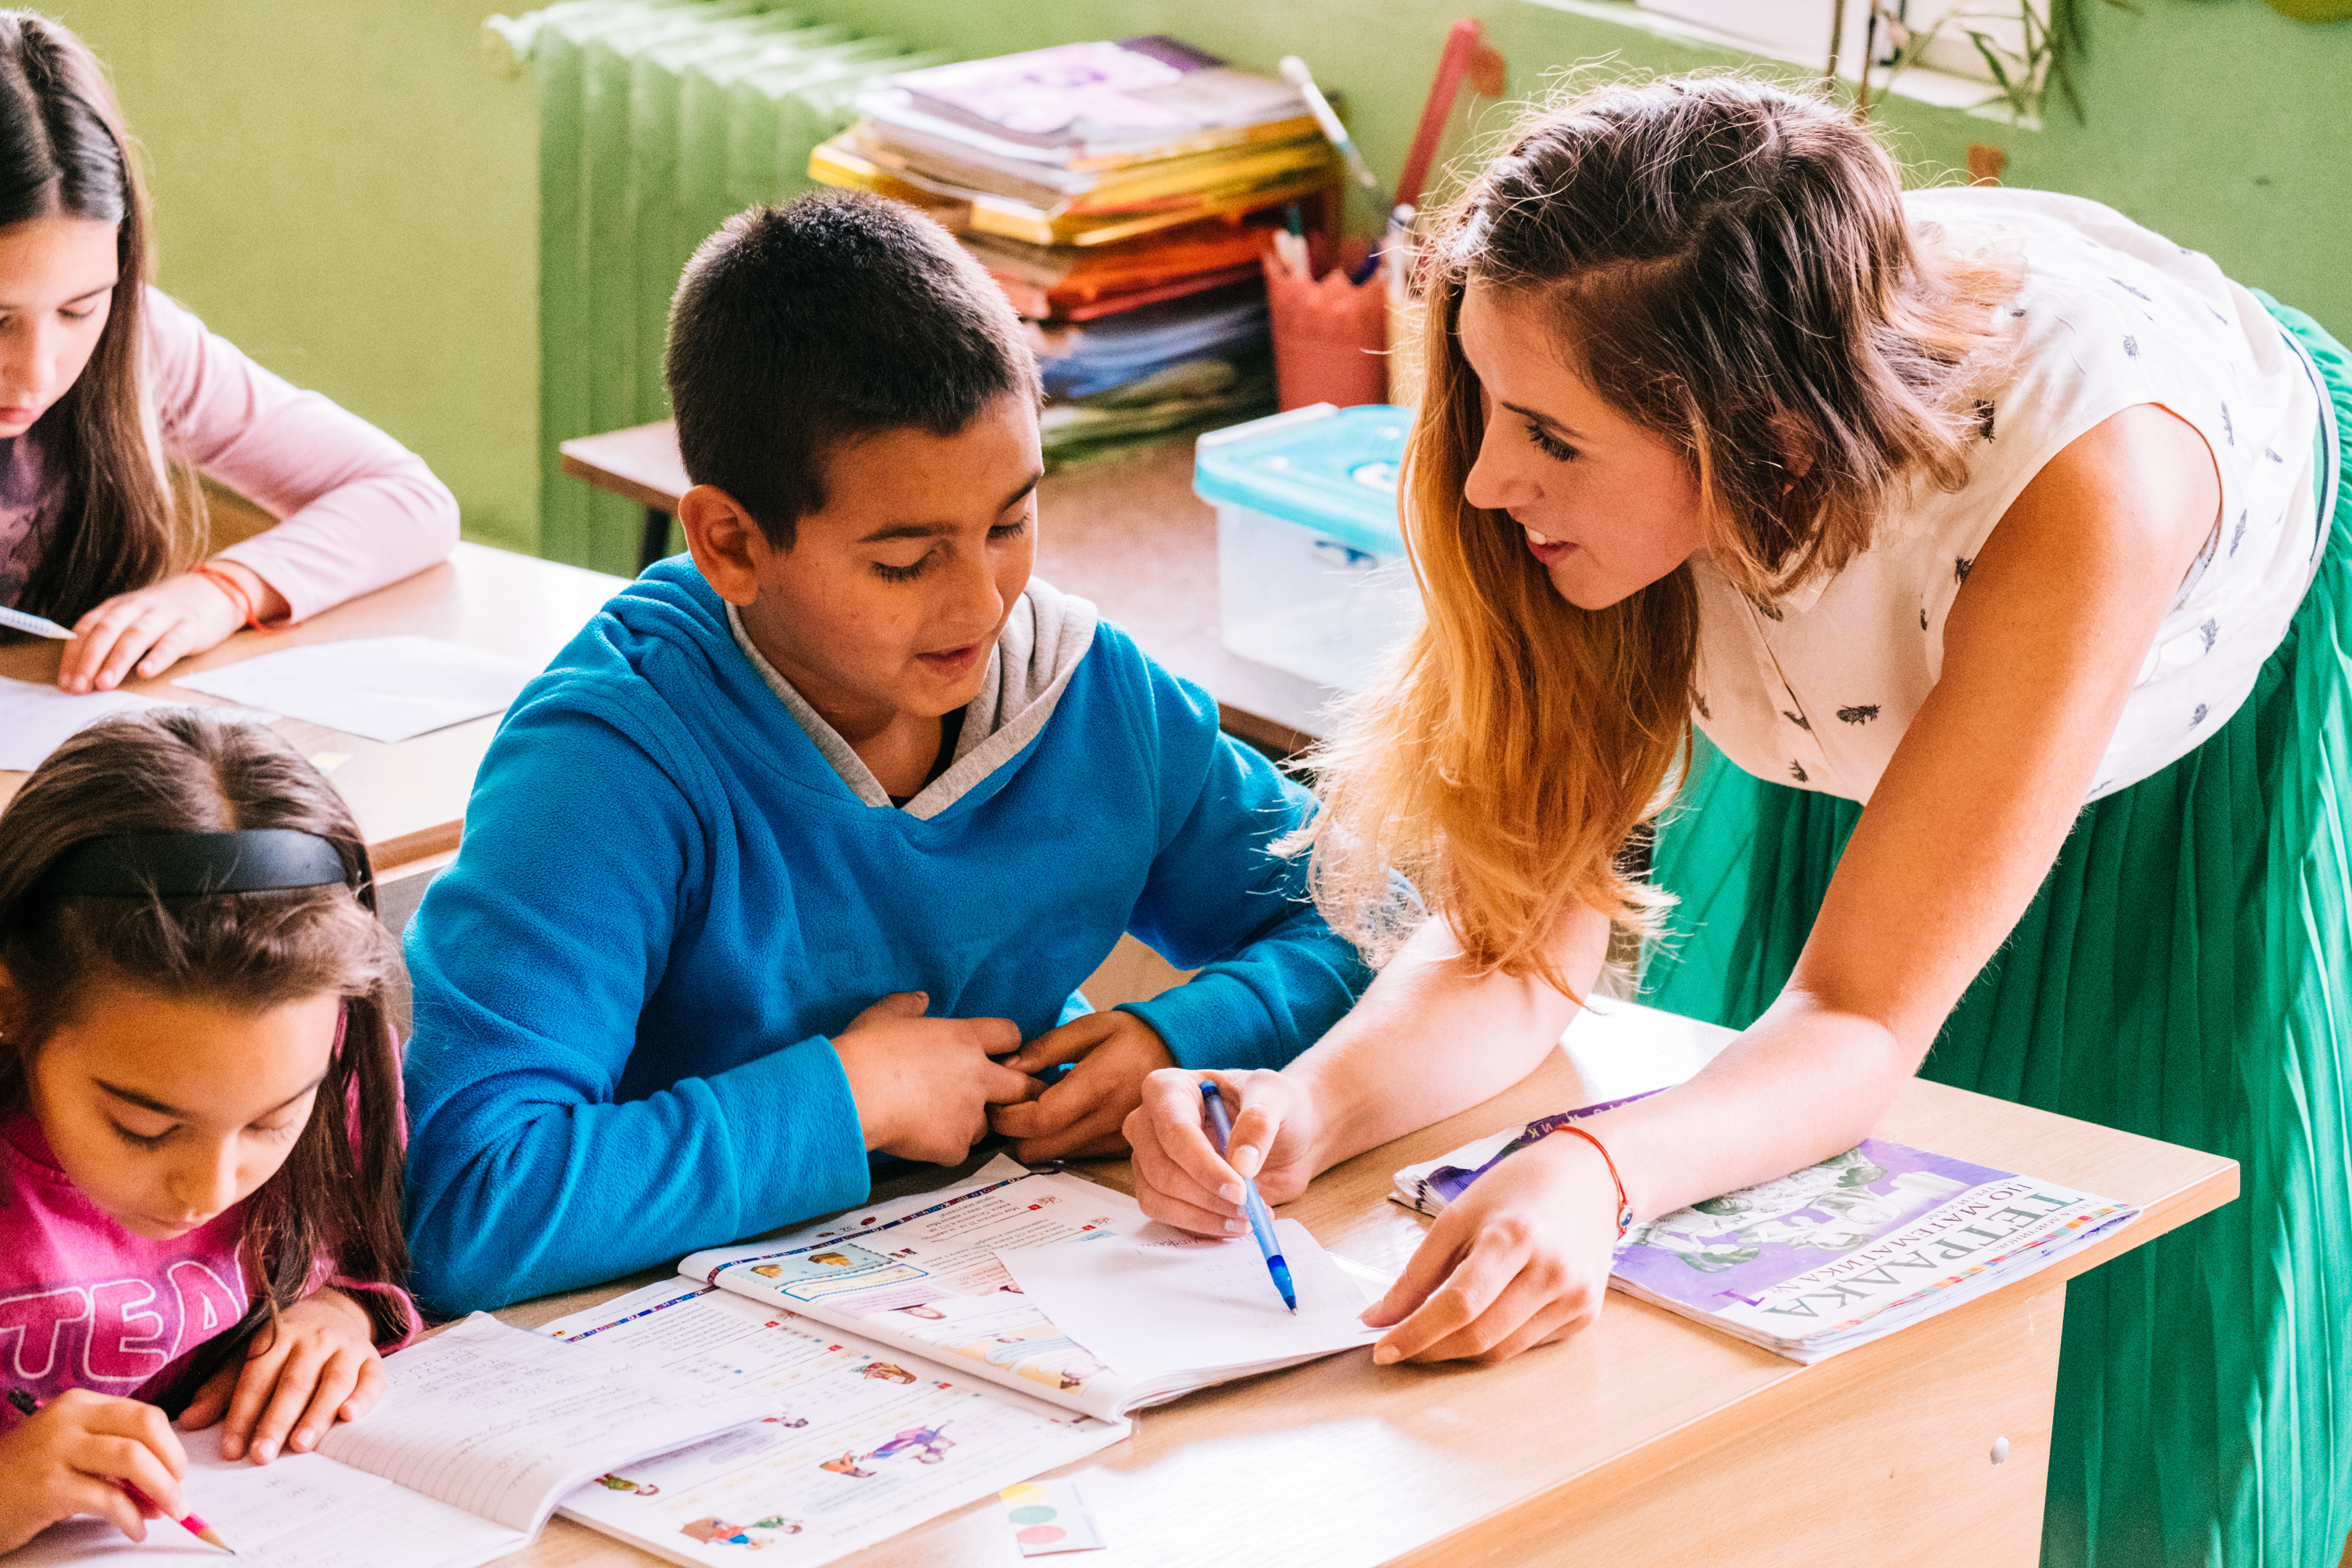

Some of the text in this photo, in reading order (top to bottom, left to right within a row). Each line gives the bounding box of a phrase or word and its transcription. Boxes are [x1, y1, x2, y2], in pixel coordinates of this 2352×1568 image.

[1920, 1181, 2014, 1223] ЗА ТРЕТИ КЛАС
[1989, 1183, 2035, 1200] ПО
[895, 1194, 970, 1224] ПРИКЛЮЧЕНИЕ
[982, 1199, 1005, 1208] Колко
[2060, 1201, 2100, 1216] СТЕЛА
[976, 1211, 1004, 1222] платила
[1797, 1201, 1993, 1282] МАТЕМАТИКА
[1759, 1192, 2085, 1318] ТЕТРАДКА
[0, 1239, 249, 1382] TEA
[677, 1305, 707, 1319] ученици
[585, 1313, 641, 1336] ГОЛЯМОТО
[657, 1318, 677, 1327] общо
[626, 1335, 650, 1344] Колко
[671, 1321, 747, 1352] състезание участвали
[696, 1327, 748, 1348] математическо
